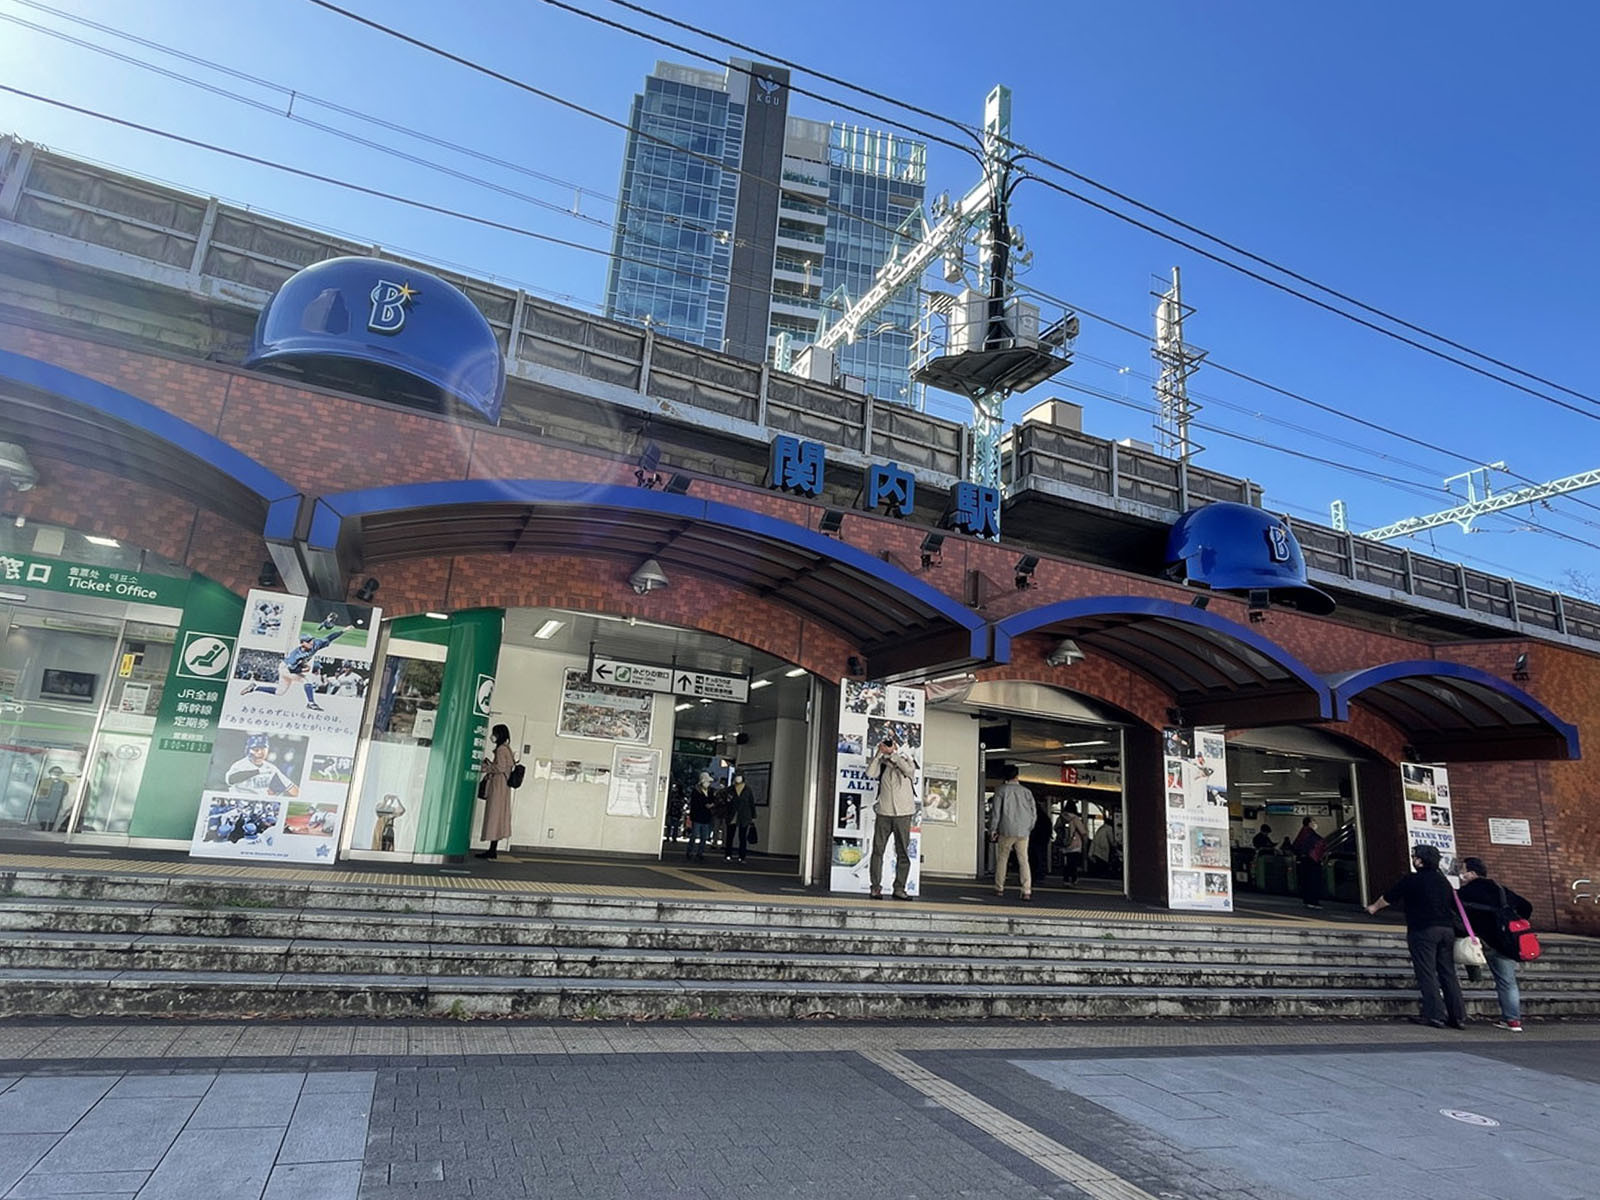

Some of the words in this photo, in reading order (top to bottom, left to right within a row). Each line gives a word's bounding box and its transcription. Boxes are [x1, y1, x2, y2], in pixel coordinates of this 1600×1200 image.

[368, 280, 405, 331] B
[771, 434, 1000, 537] 関内駅
[0, 556, 52, 583] 窓口
[67, 576, 112, 592] Ticket
[115, 583, 158, 599] Office
[177, 689, 219, 702] JR全線
[176, 702, 212, 715] 新幹線
[173, 716, 209, 729] 定期券
[847, 781, 874, 791] ALL
